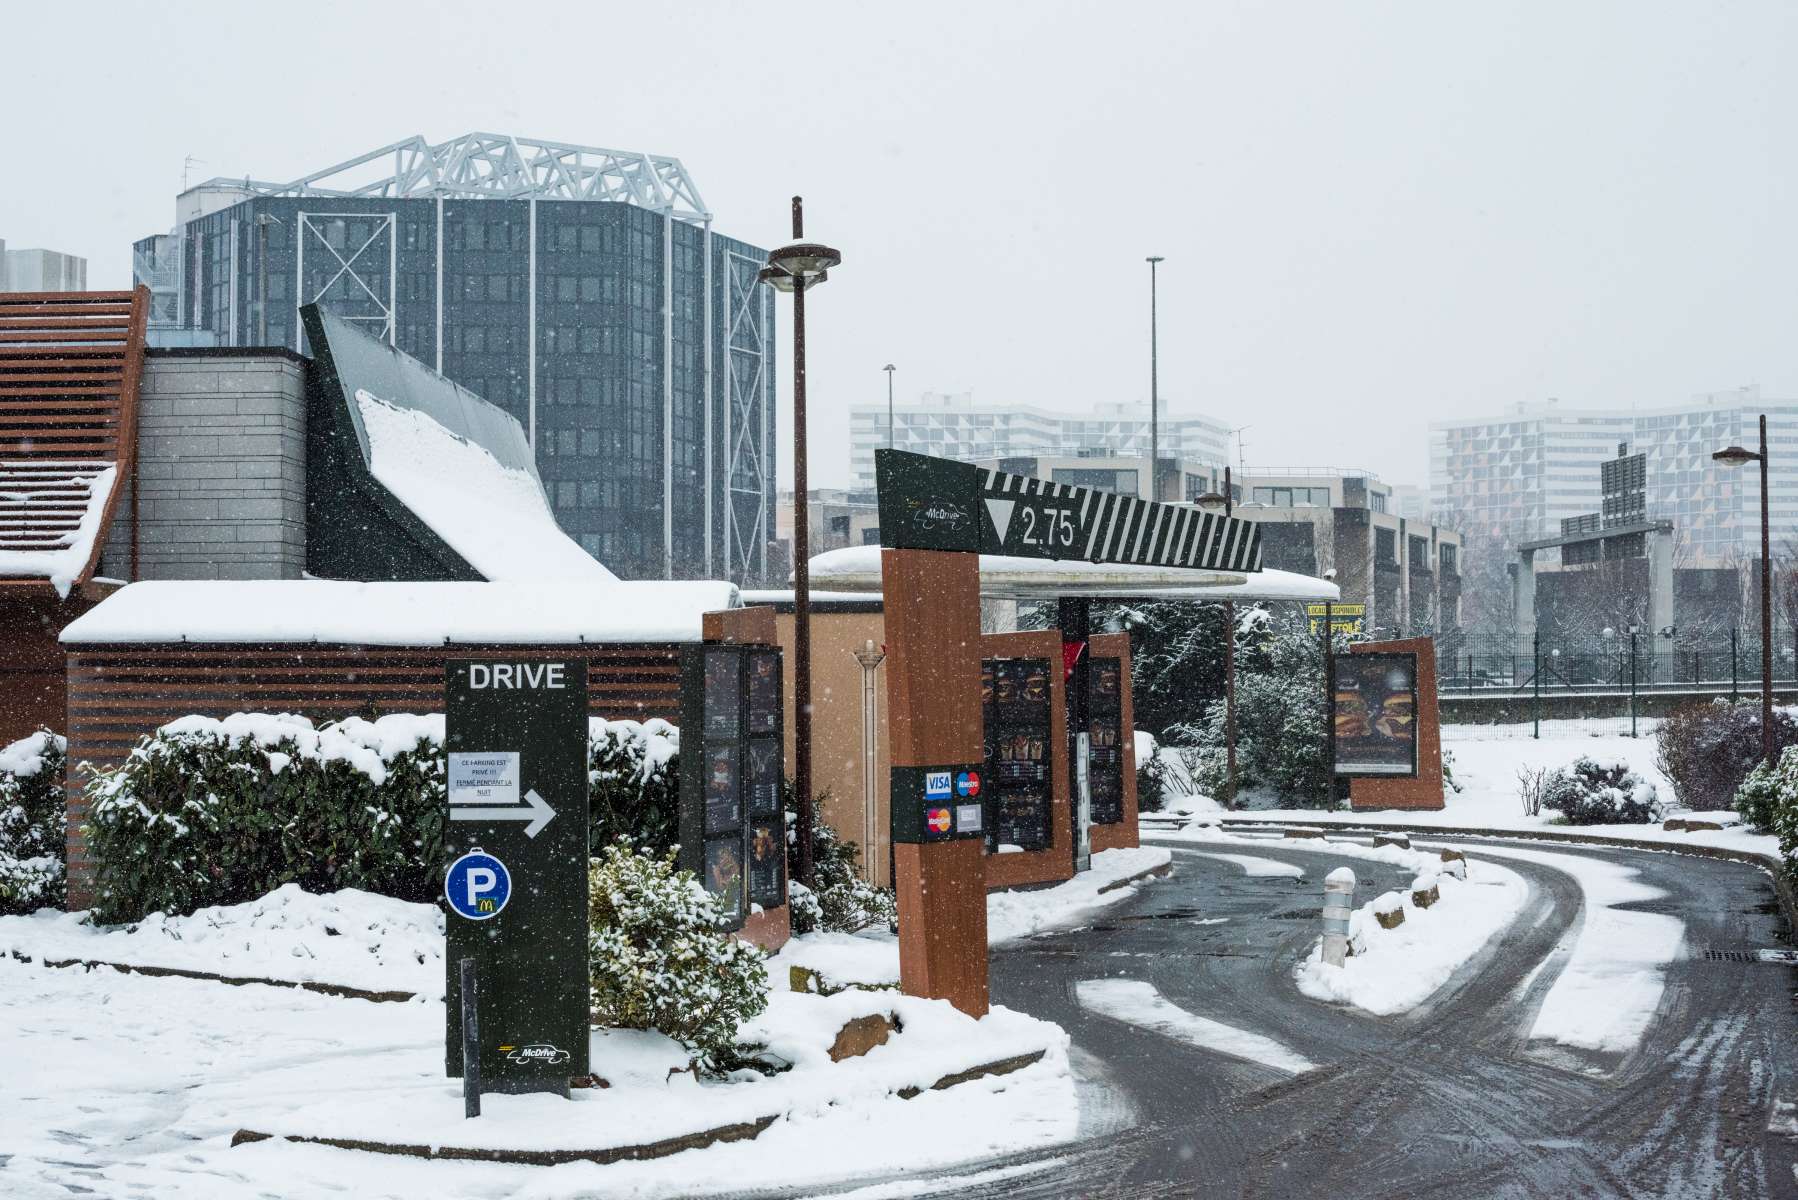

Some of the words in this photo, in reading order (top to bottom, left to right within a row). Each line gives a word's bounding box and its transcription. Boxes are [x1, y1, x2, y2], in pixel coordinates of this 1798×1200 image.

[927, 507, 960, 520] McDrive
[1021, 506, 1074, 546] 2.75
[469, 663, 566, 689] DRIVE
[929, 776, 951, 790] VISA
[466, 867, 497, 906] P
[521, 1048, 557, 1057] McDrive
